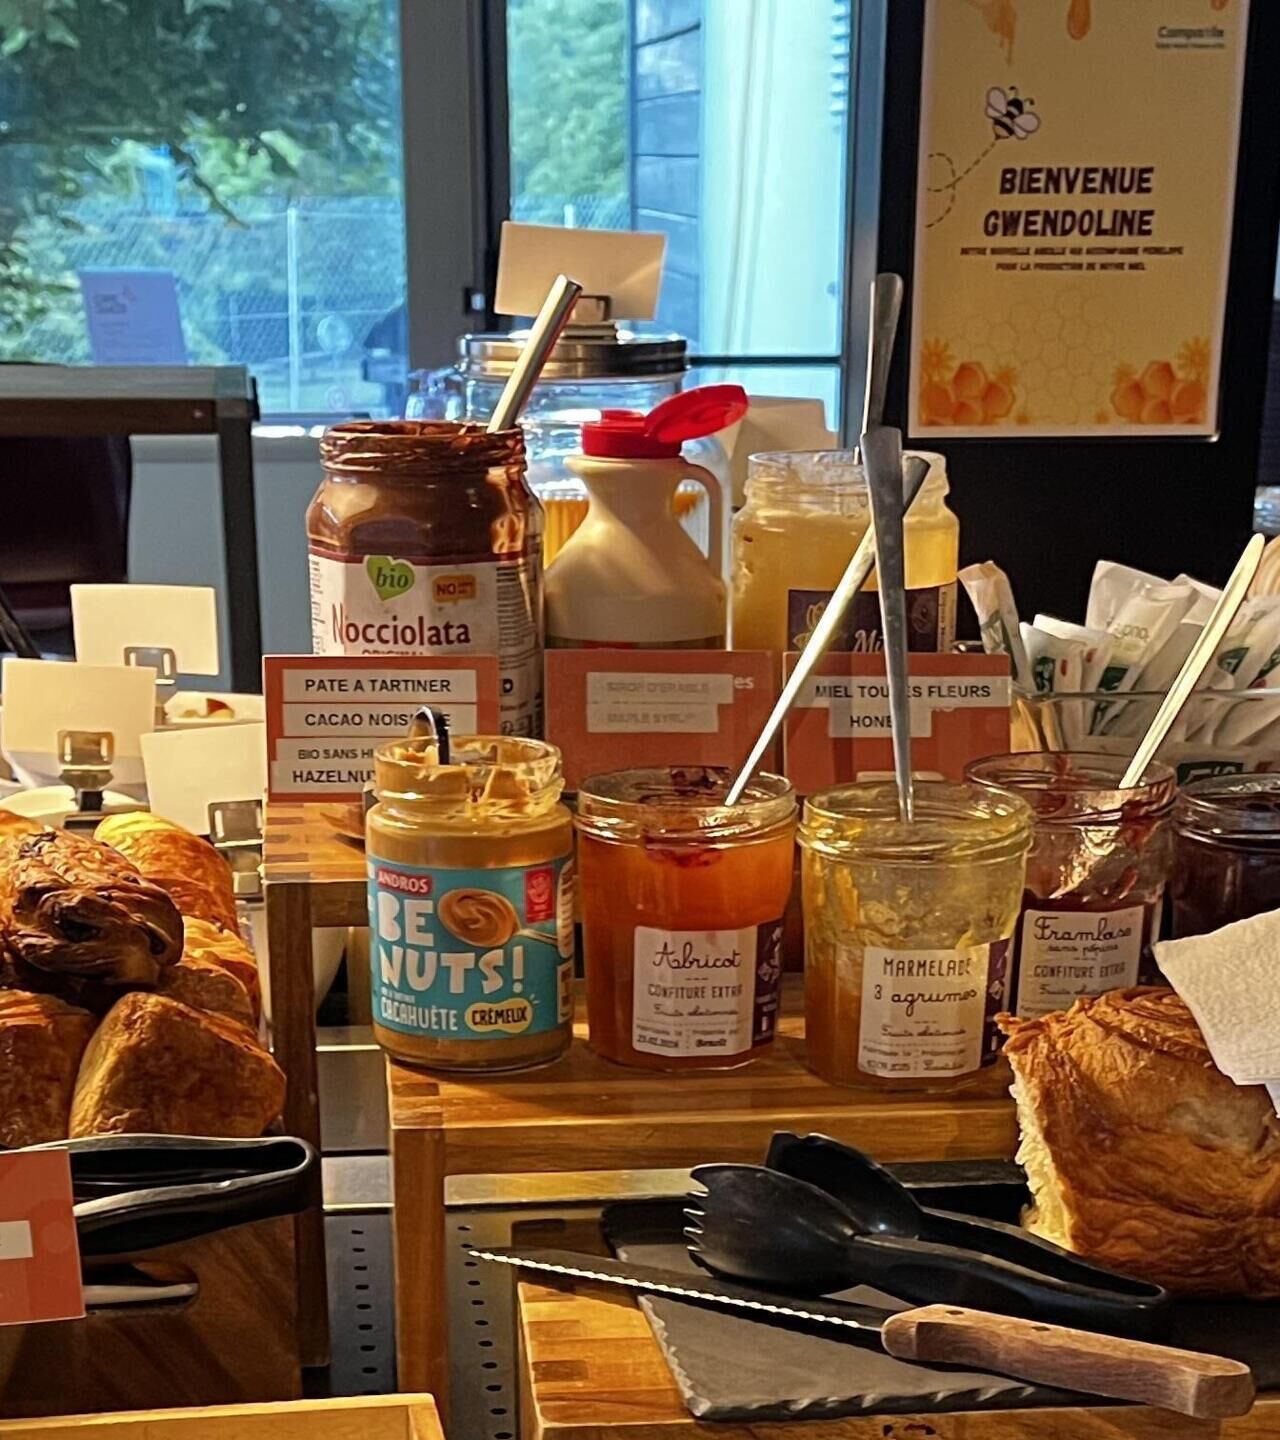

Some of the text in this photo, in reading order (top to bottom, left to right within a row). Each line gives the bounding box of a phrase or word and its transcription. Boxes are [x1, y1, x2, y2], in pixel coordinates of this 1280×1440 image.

[1000, 167, 1154, 194] BIENVENUE
[984, 210, 1154, 237] GWENDOLINE
[376, 567, 409, 588] bio
[436, 582, 457, 595] NO
[332, 603, 472, 646] Nocciolata
[305, 679, 451, 693] PATE A TARTINER
[815, 685, 991, 698] MIEL TOUS FLEURS
[304, 713, 451, 727] CACAO NOISE
[850, 715, 893, 728] HONE
[298, 749, 319, 760] BIO
[322, 749, 358, 760] SANS
[377, 870, 430, 894] ANDROS
[377, 891, 435, 947] BE
[652, 941, 742, 970] Abricot
[379, 944, 524, 994] NUTS!
[882, 957, 973, 977] MARMELADE
[1033, 962, 1126, 979] CONFITURE EXTRA
[647, 983, 743, 999] CONFITURE EXTRA
[873, 984, 978, 1018] 3 agrumes
[381, 997, 459, 1031] CACAHUÈTE
